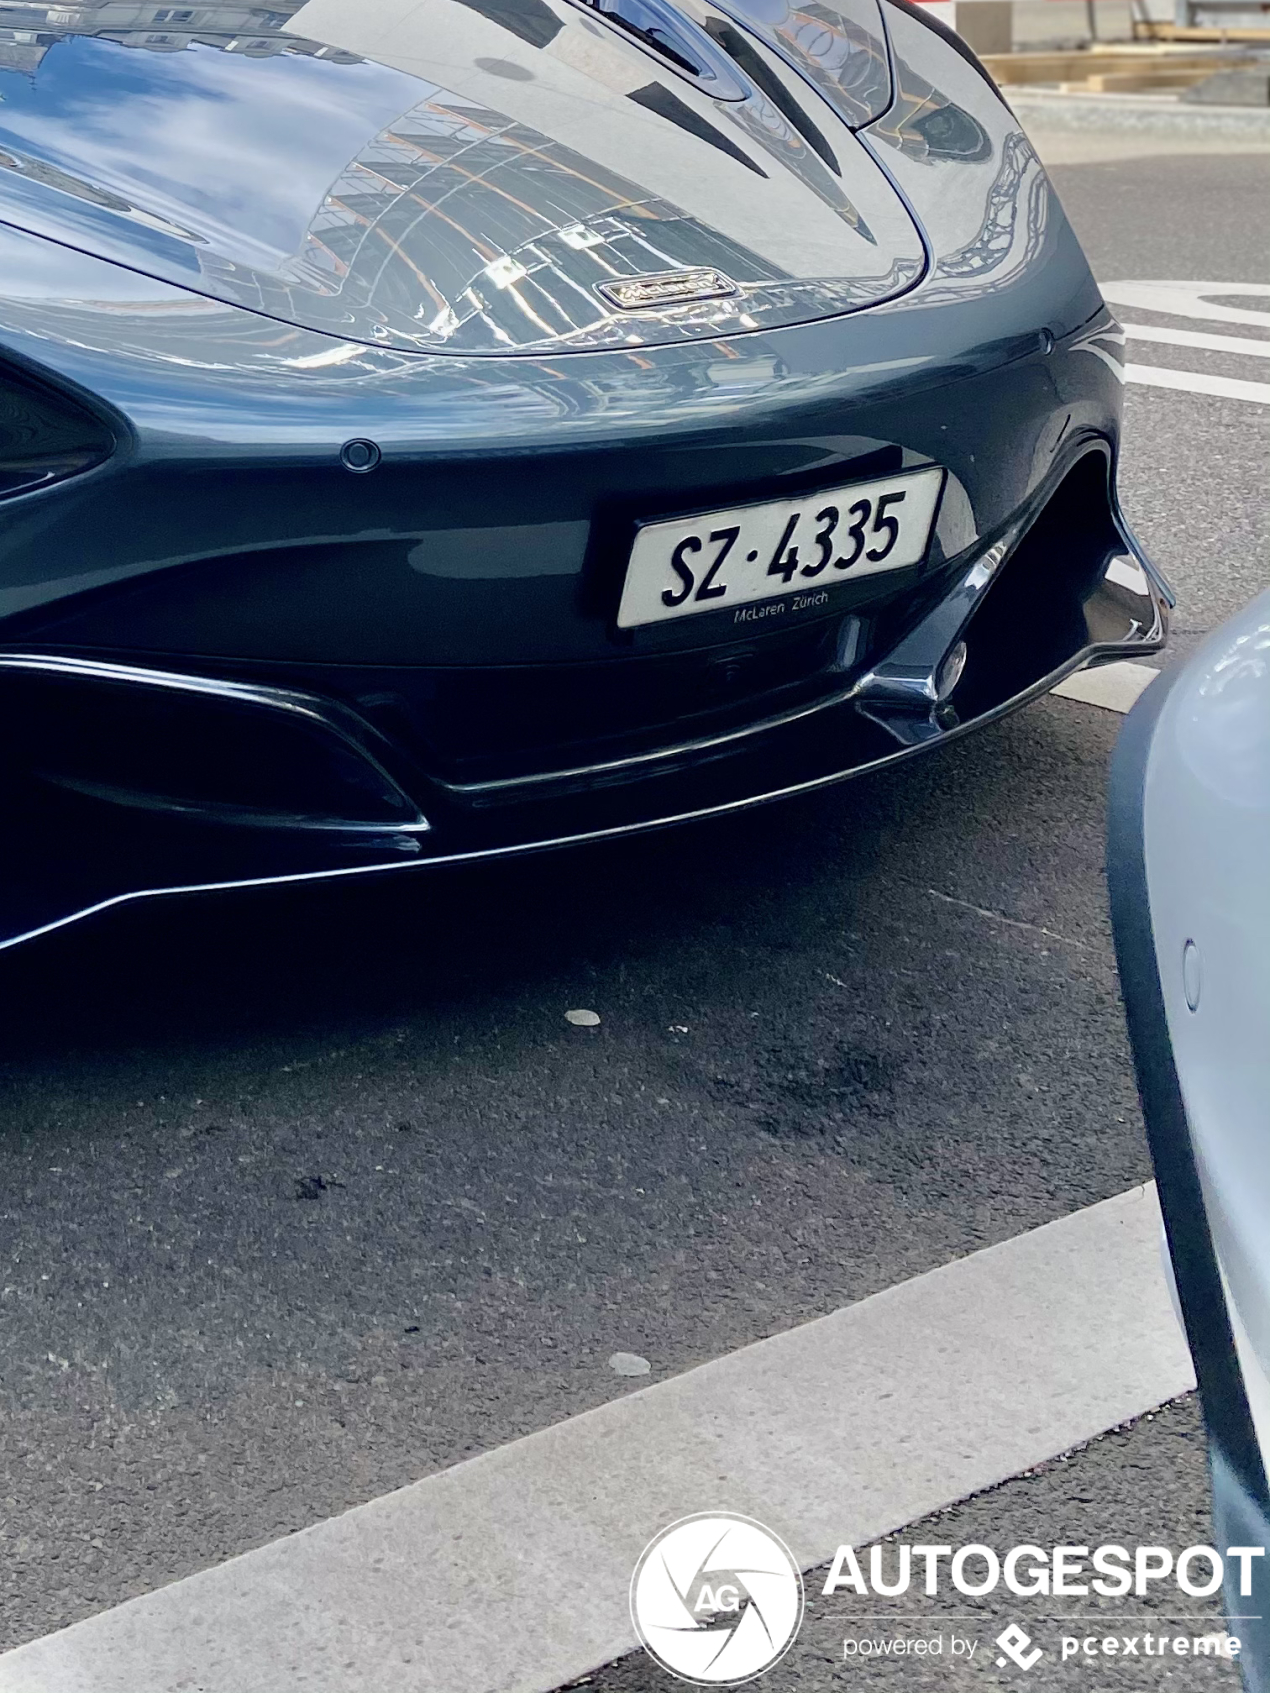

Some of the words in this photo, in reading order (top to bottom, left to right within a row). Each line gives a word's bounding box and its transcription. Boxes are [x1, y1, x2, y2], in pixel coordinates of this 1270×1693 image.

[624, 280, 713, 299] McLaren
[733, 602, 785, 624] McLaren
[791, 590, 829, 611] Zürich
